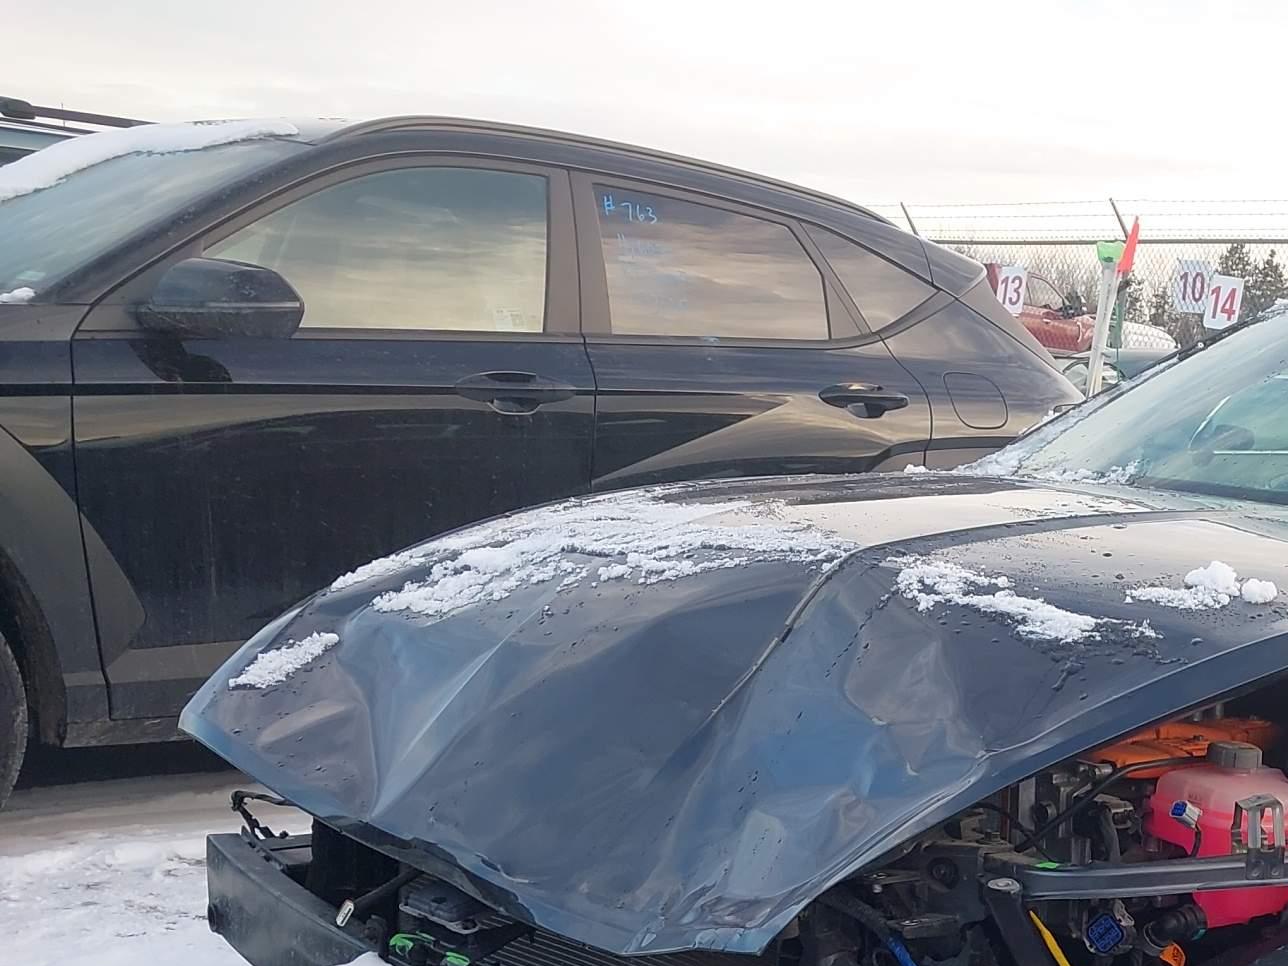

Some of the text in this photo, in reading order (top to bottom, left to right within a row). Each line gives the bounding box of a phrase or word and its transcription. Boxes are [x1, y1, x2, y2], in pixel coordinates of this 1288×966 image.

[1000, 274, 1023, 306] 13
[1180, 270, 1206, 302] 10
[1210, 285, 1238, 321] 14
